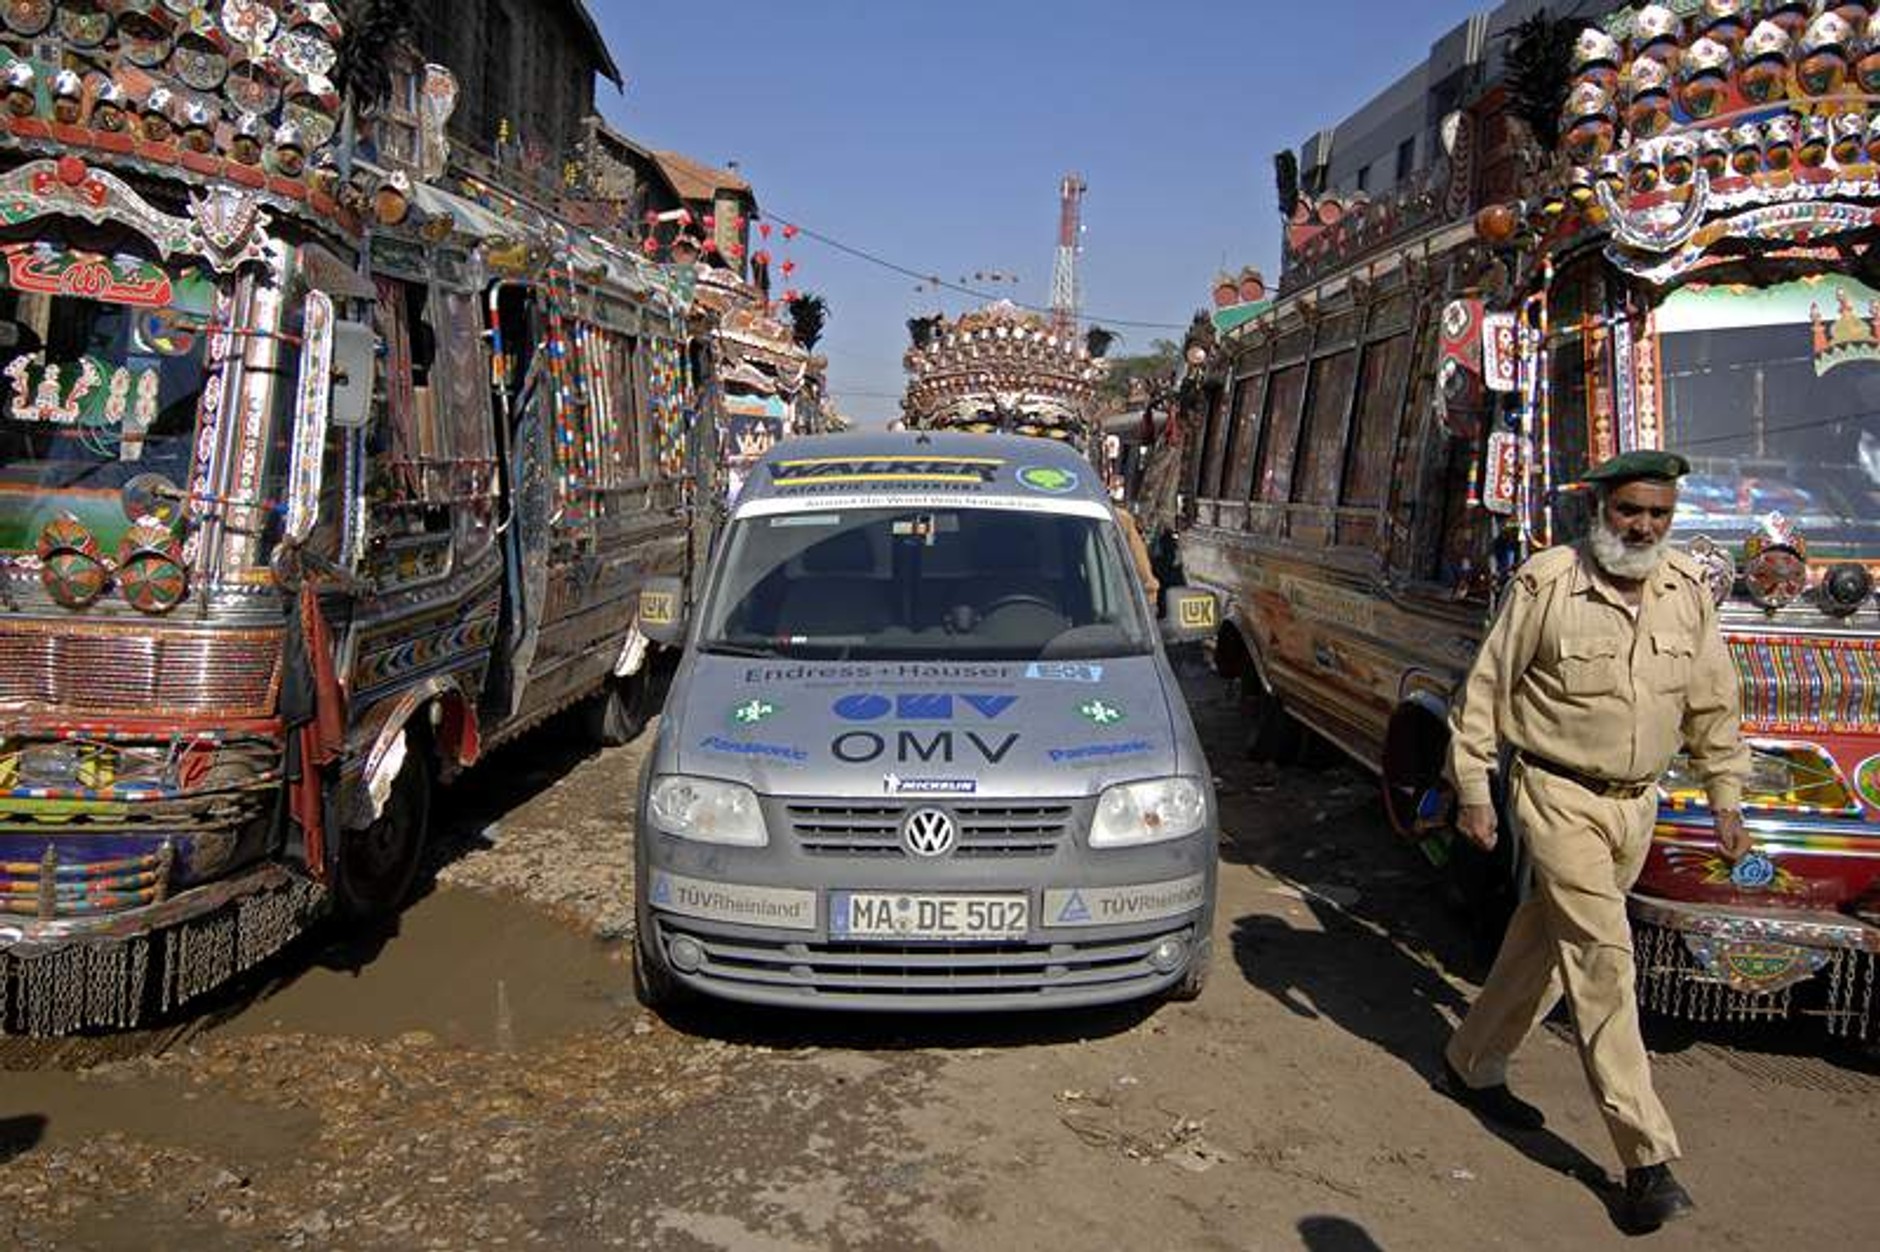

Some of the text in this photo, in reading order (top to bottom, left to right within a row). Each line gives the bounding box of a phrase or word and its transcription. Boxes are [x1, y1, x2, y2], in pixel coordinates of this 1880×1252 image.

[831, 730, 1021, 764] OMV
[852, 899, 1026, 932] MA DE 502
